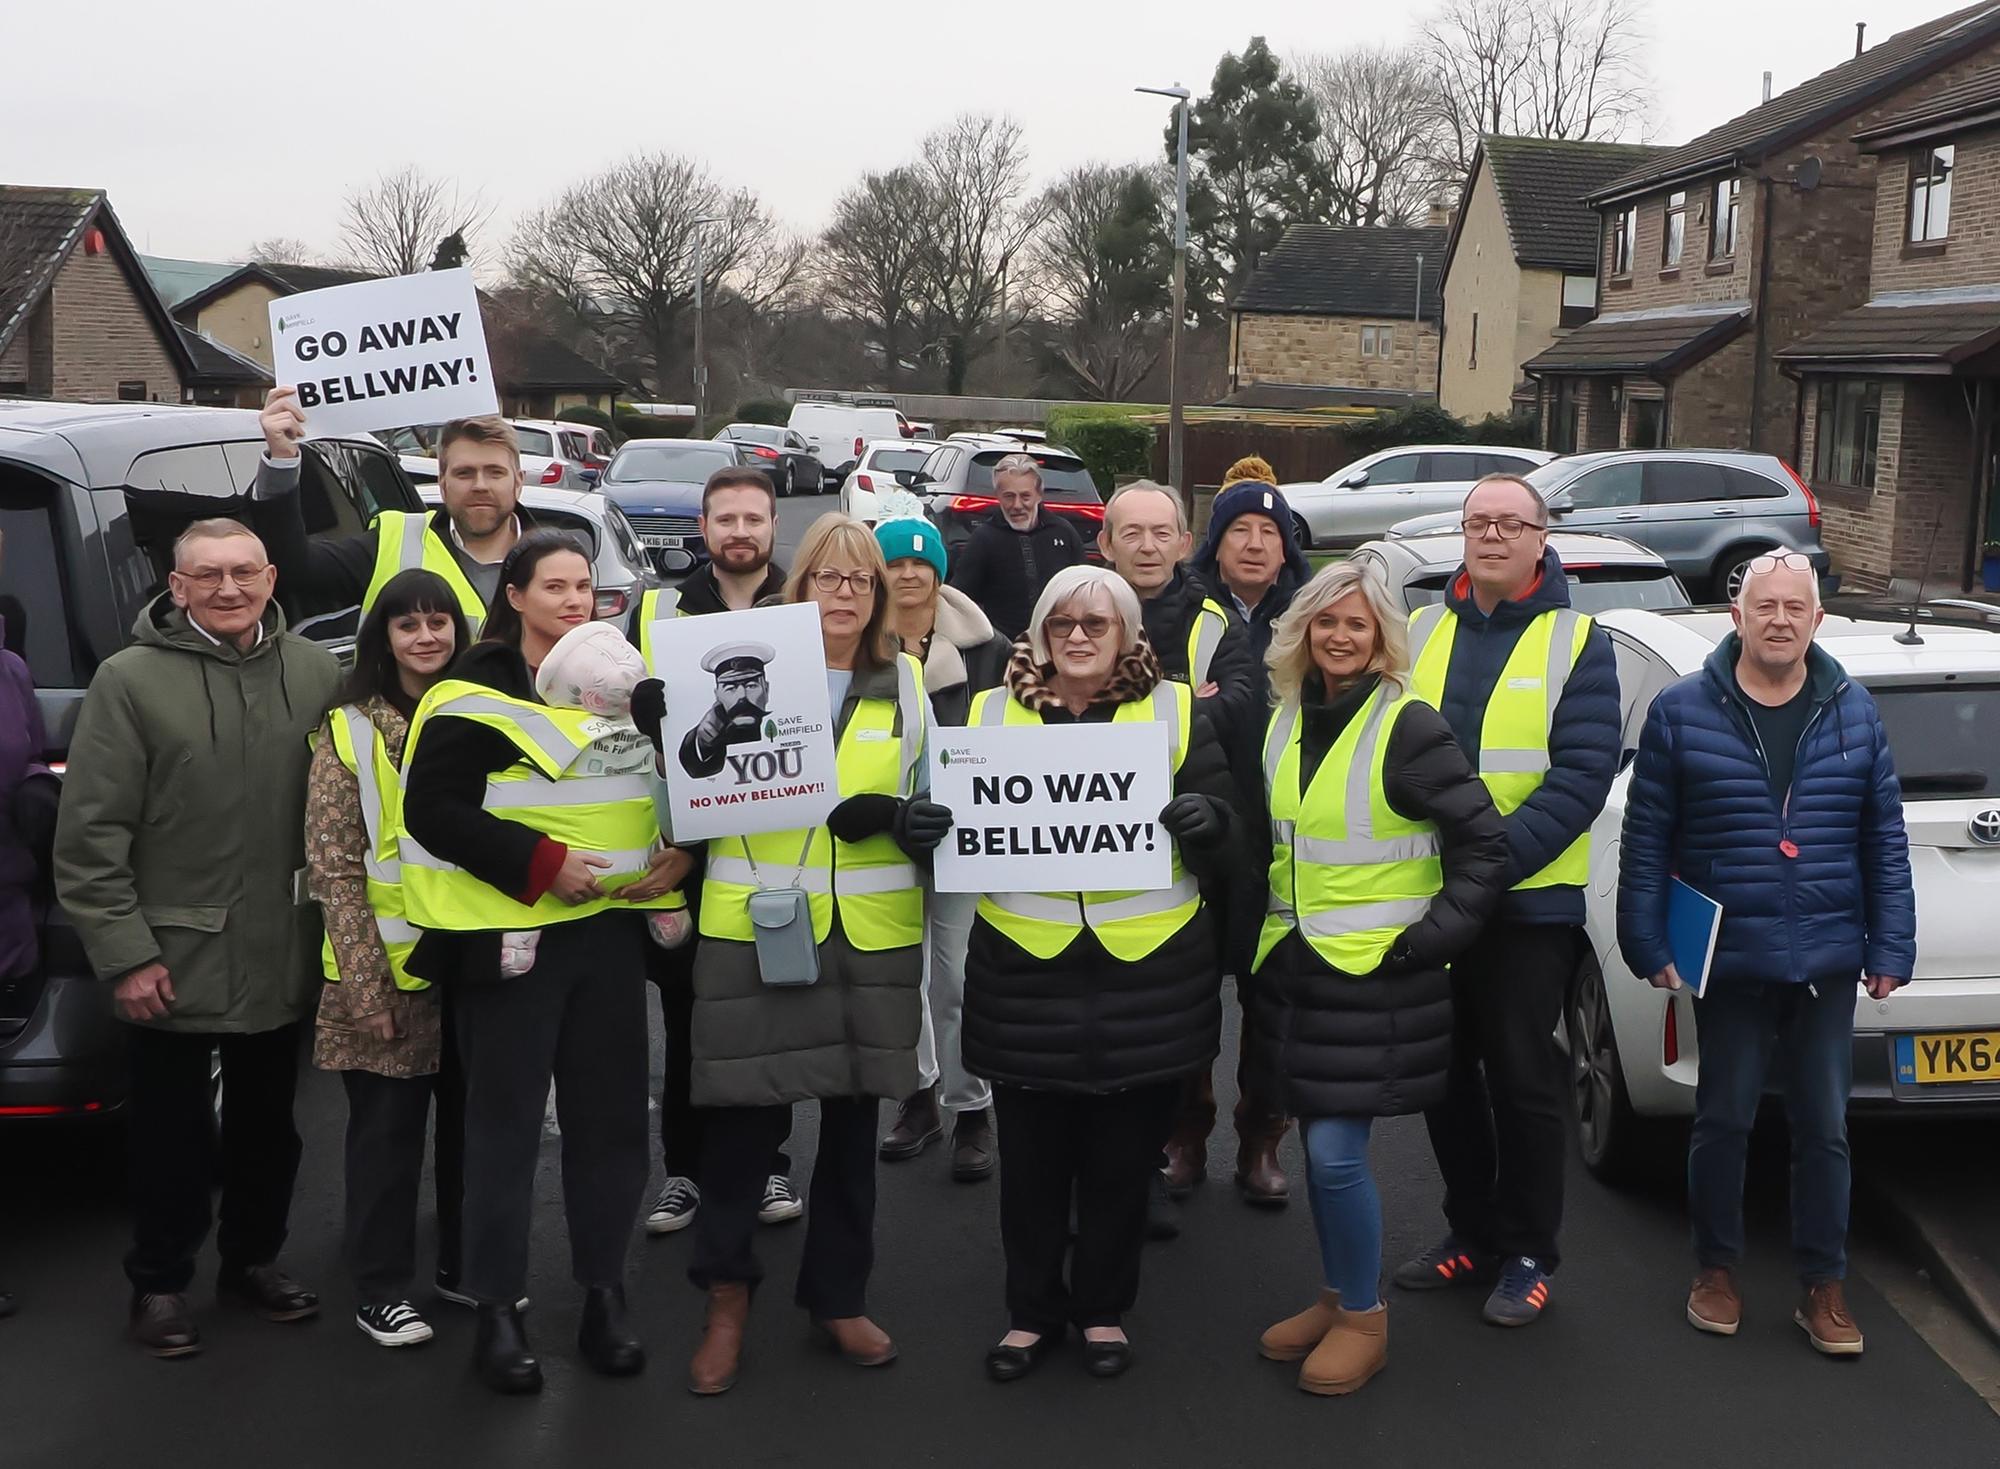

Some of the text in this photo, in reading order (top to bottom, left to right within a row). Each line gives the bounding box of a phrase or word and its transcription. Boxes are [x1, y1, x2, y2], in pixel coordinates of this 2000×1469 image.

[294, 312, 461, 361] GO AWAY
[296, 357, 477, 408] BELLWAY!
[777, 715, 803, 726] SAVE
[778, 724, 823, 737] MIRFIELD
[726, 745, 808, 785] YOU
[950, 756, 987, 765] MIRFIELD
[689, 782, 825, 809] NO WAY BELLWAY!!
[972, 772, 1136, 805] NO WAY
[957, 823, 1155, 855] BELLWAY!
[1920, 1038, 2000, 1075] YK6
